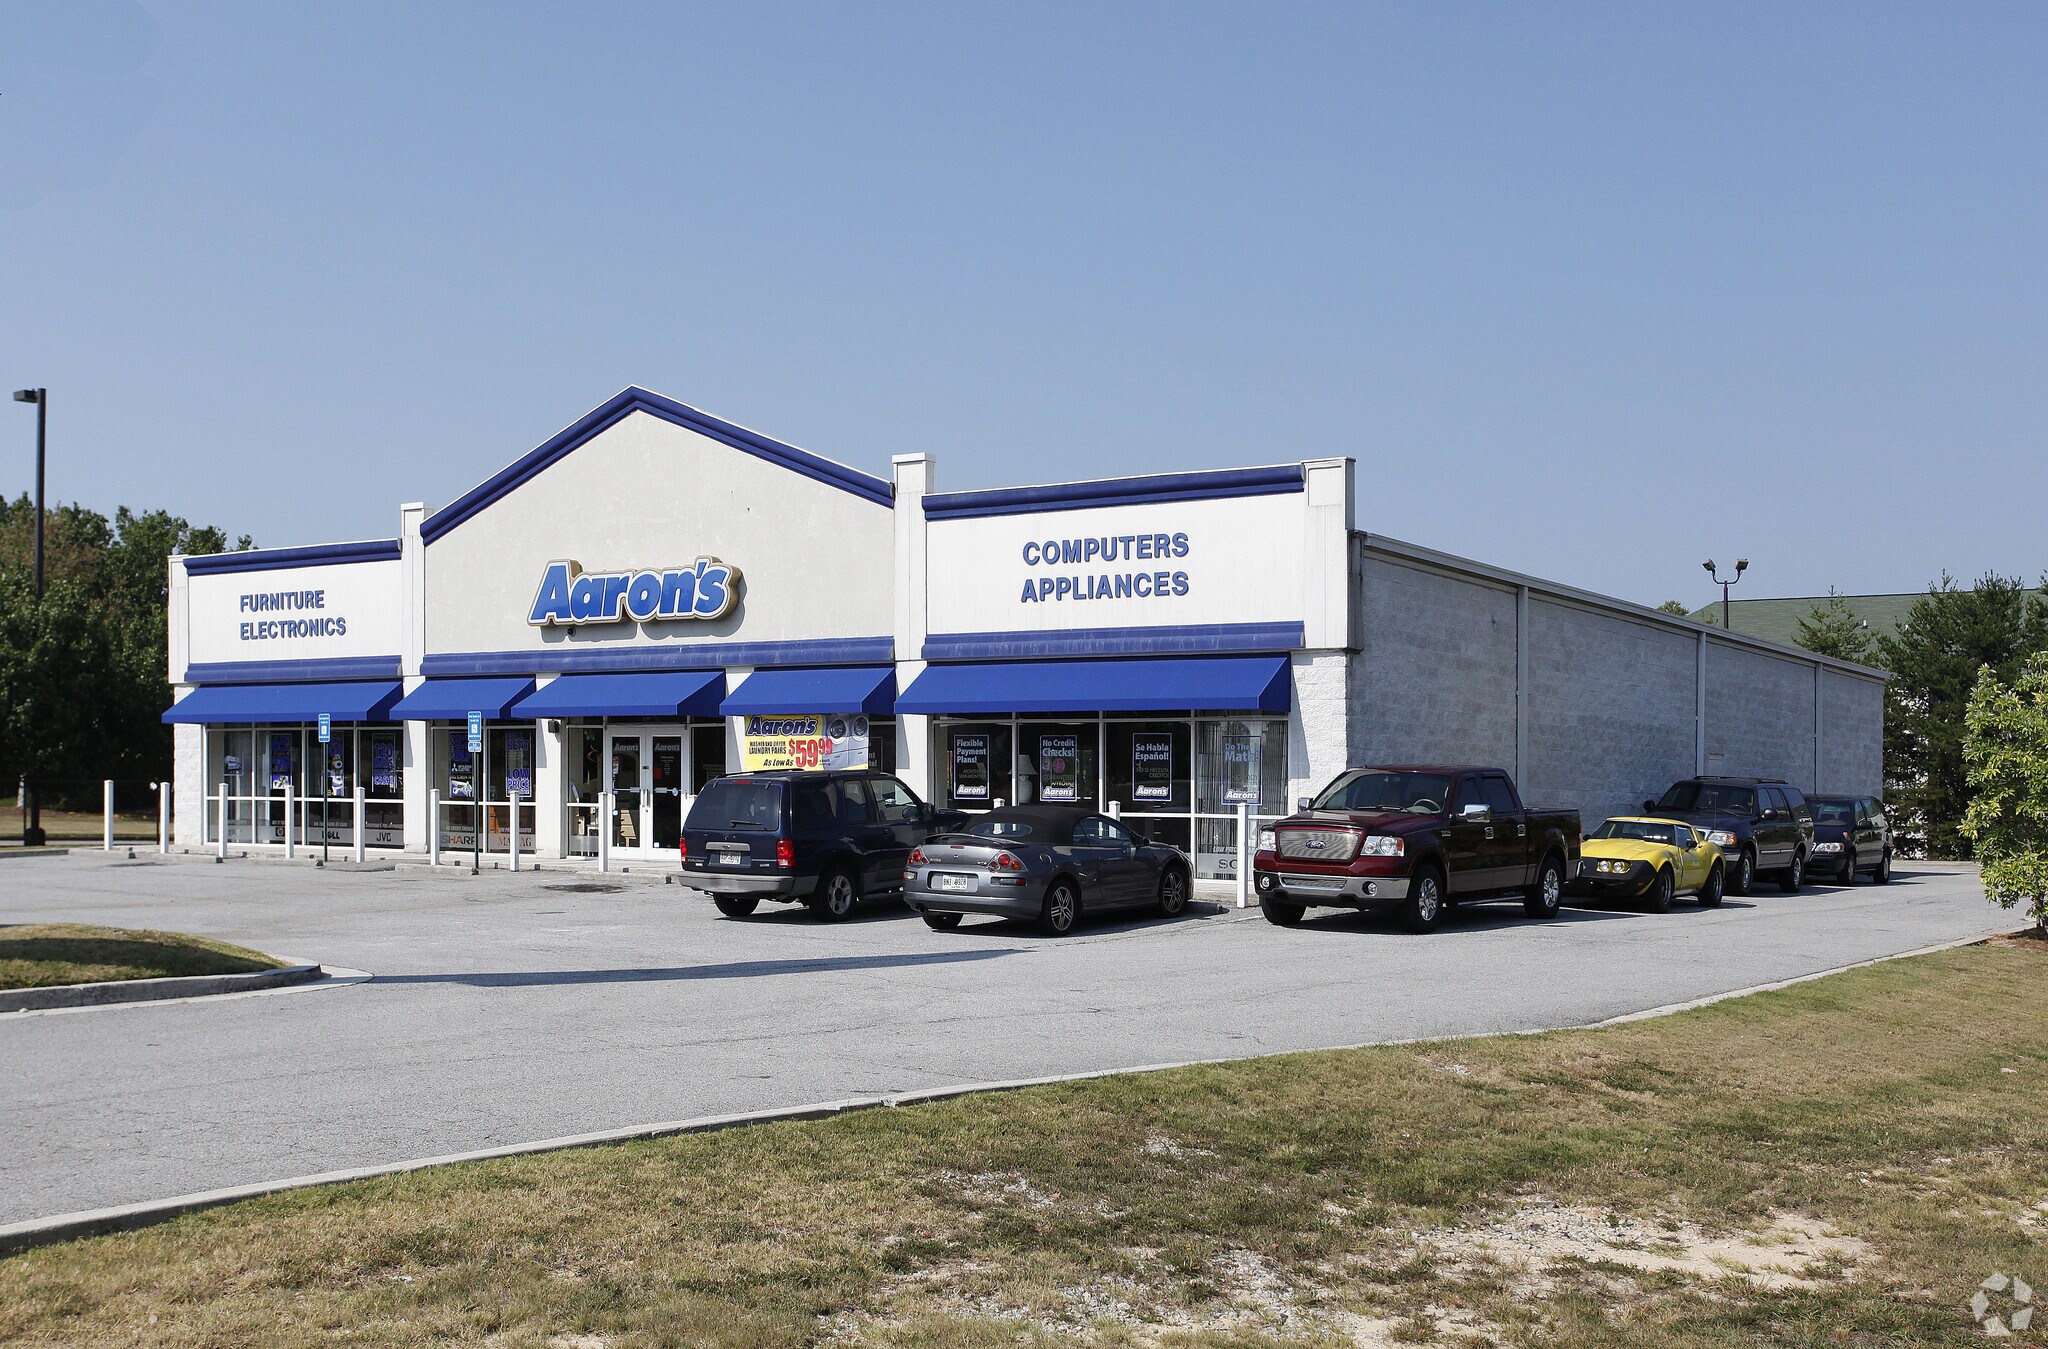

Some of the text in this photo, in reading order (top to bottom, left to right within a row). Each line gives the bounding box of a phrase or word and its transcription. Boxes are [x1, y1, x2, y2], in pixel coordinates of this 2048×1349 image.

[1022, 532, 1190, 566] COMPUTERS
[528, 556, 734, 626] Aaron's
[1020, 571, 1190, 603] APPLIANCES
[240, 589, 325, 613] FURNITURE
[240, 616, 347, 641] ELECTRONICS
[747, 716, 818, 736] Aaron's
[507, 740, 530, 750] BEAT
[614, 743, 639, 751] Aaron's
[655, 743, 680, 751] Aaron's
[956, 739, 984, 747] Flexible
[1042, 739, 1075, 747] No Credit
[1135, 743, 1169, 751] Se Habla
[1225, 743, 1251, 751] Do The
[375, 743, 393, 758] 120
[771, 746, 787, 755] PAIRS
[956, 748, 987, 757] Payment
[1042, 748, 1075, 757] Checks!
[956, 756, 978, 764] Plans!
[1135, 752, 1169, 762] Español!
[1225, 750, 1259, 762] Math!
[507, 768, 530, 779] LOW
[507, 779, 530, 789] PRICE
[957, 785, 986, 795] Aaron's
[1043, 786, 1074, 797] Aaron's
[1136, 785, 1168, 796] Aaron's
[1224, 789, 1260, 800] Aaron's
[376, 832, 392, 842] JVC
